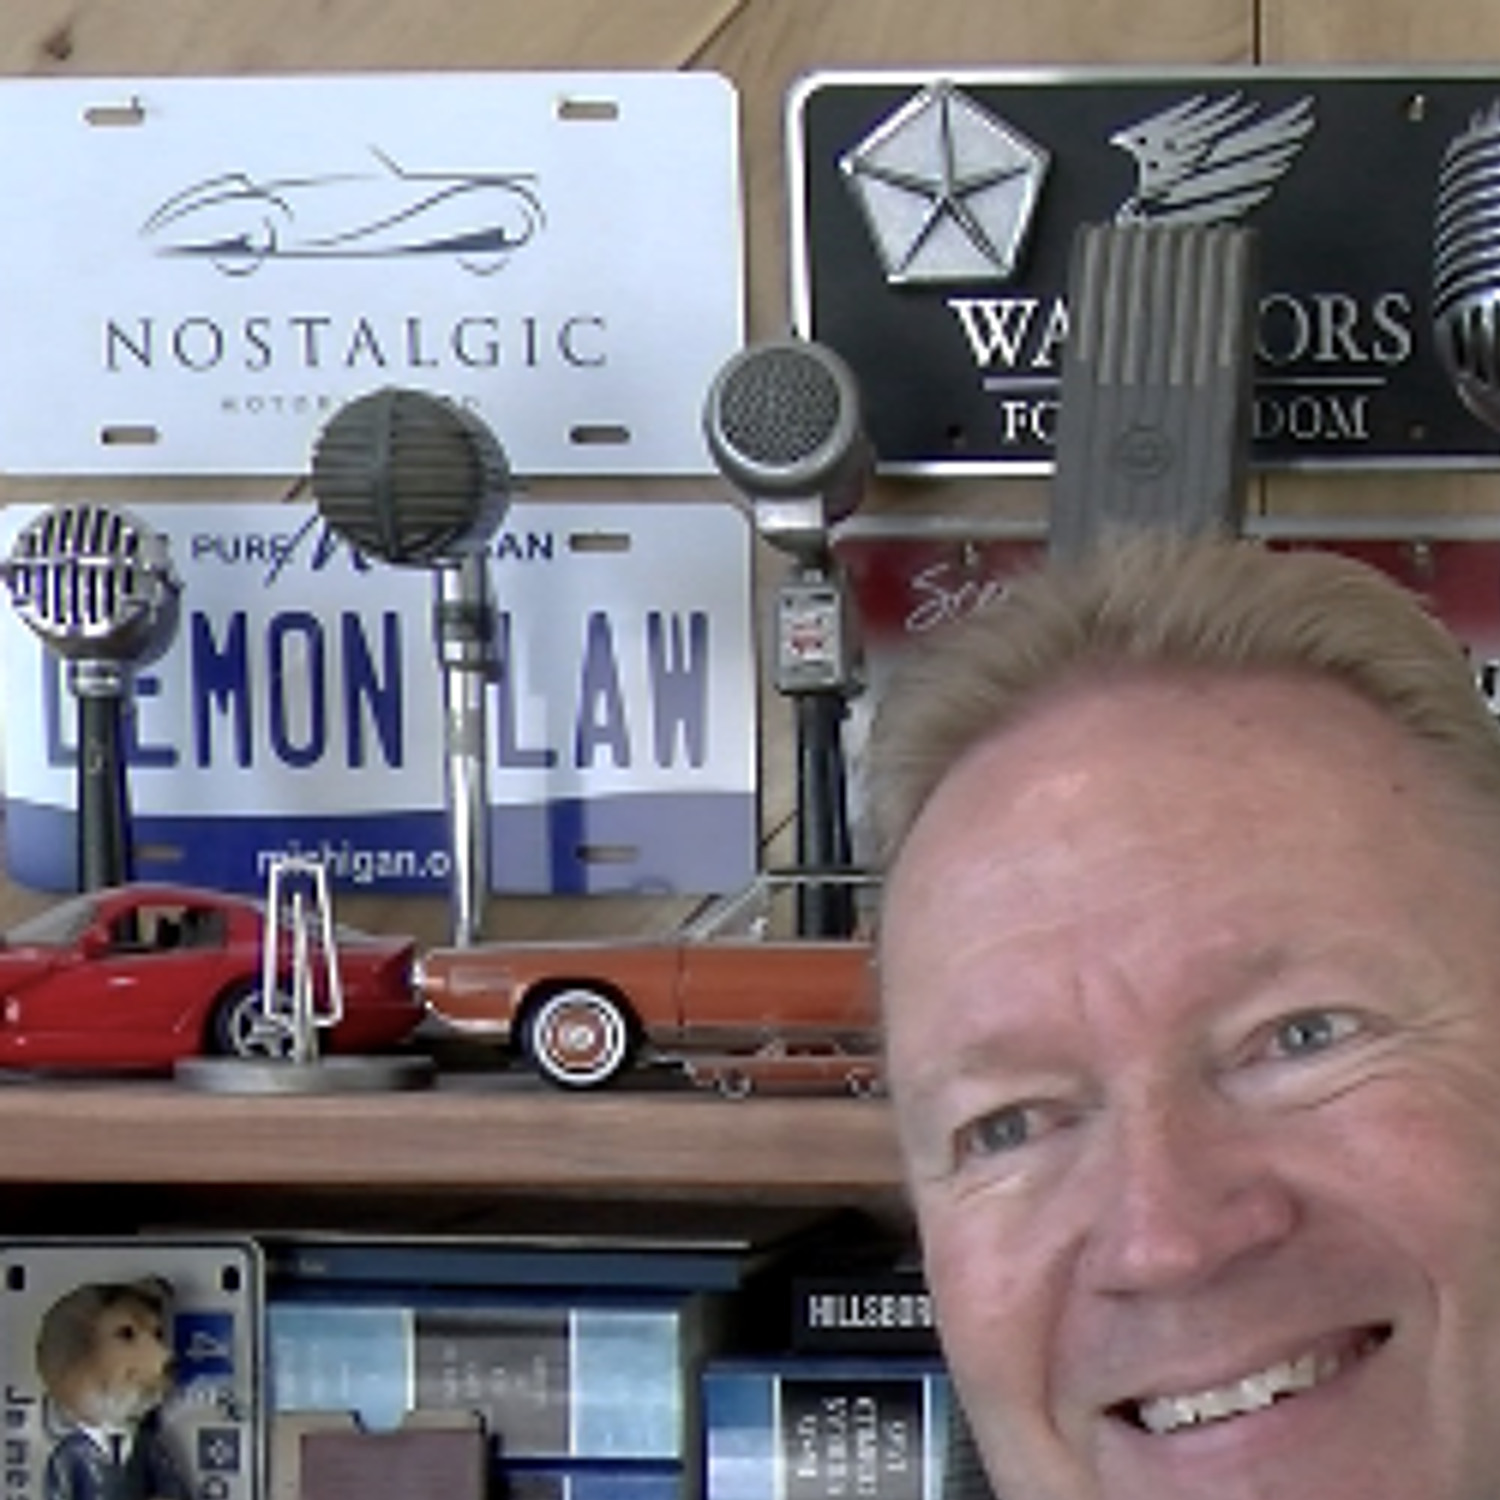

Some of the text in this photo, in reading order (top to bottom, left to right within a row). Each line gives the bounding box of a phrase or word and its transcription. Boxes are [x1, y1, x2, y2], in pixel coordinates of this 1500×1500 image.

[104, 316, 608, 371] NOSTALGIC
[948, 293, 1411, 368] WAORS
[1002, 400, 1062, 442] FO
[190, 533, 293, 563] PURE
[497, 611, 708, 770] LAW
[258, 845, 450, 882] michigan.o
